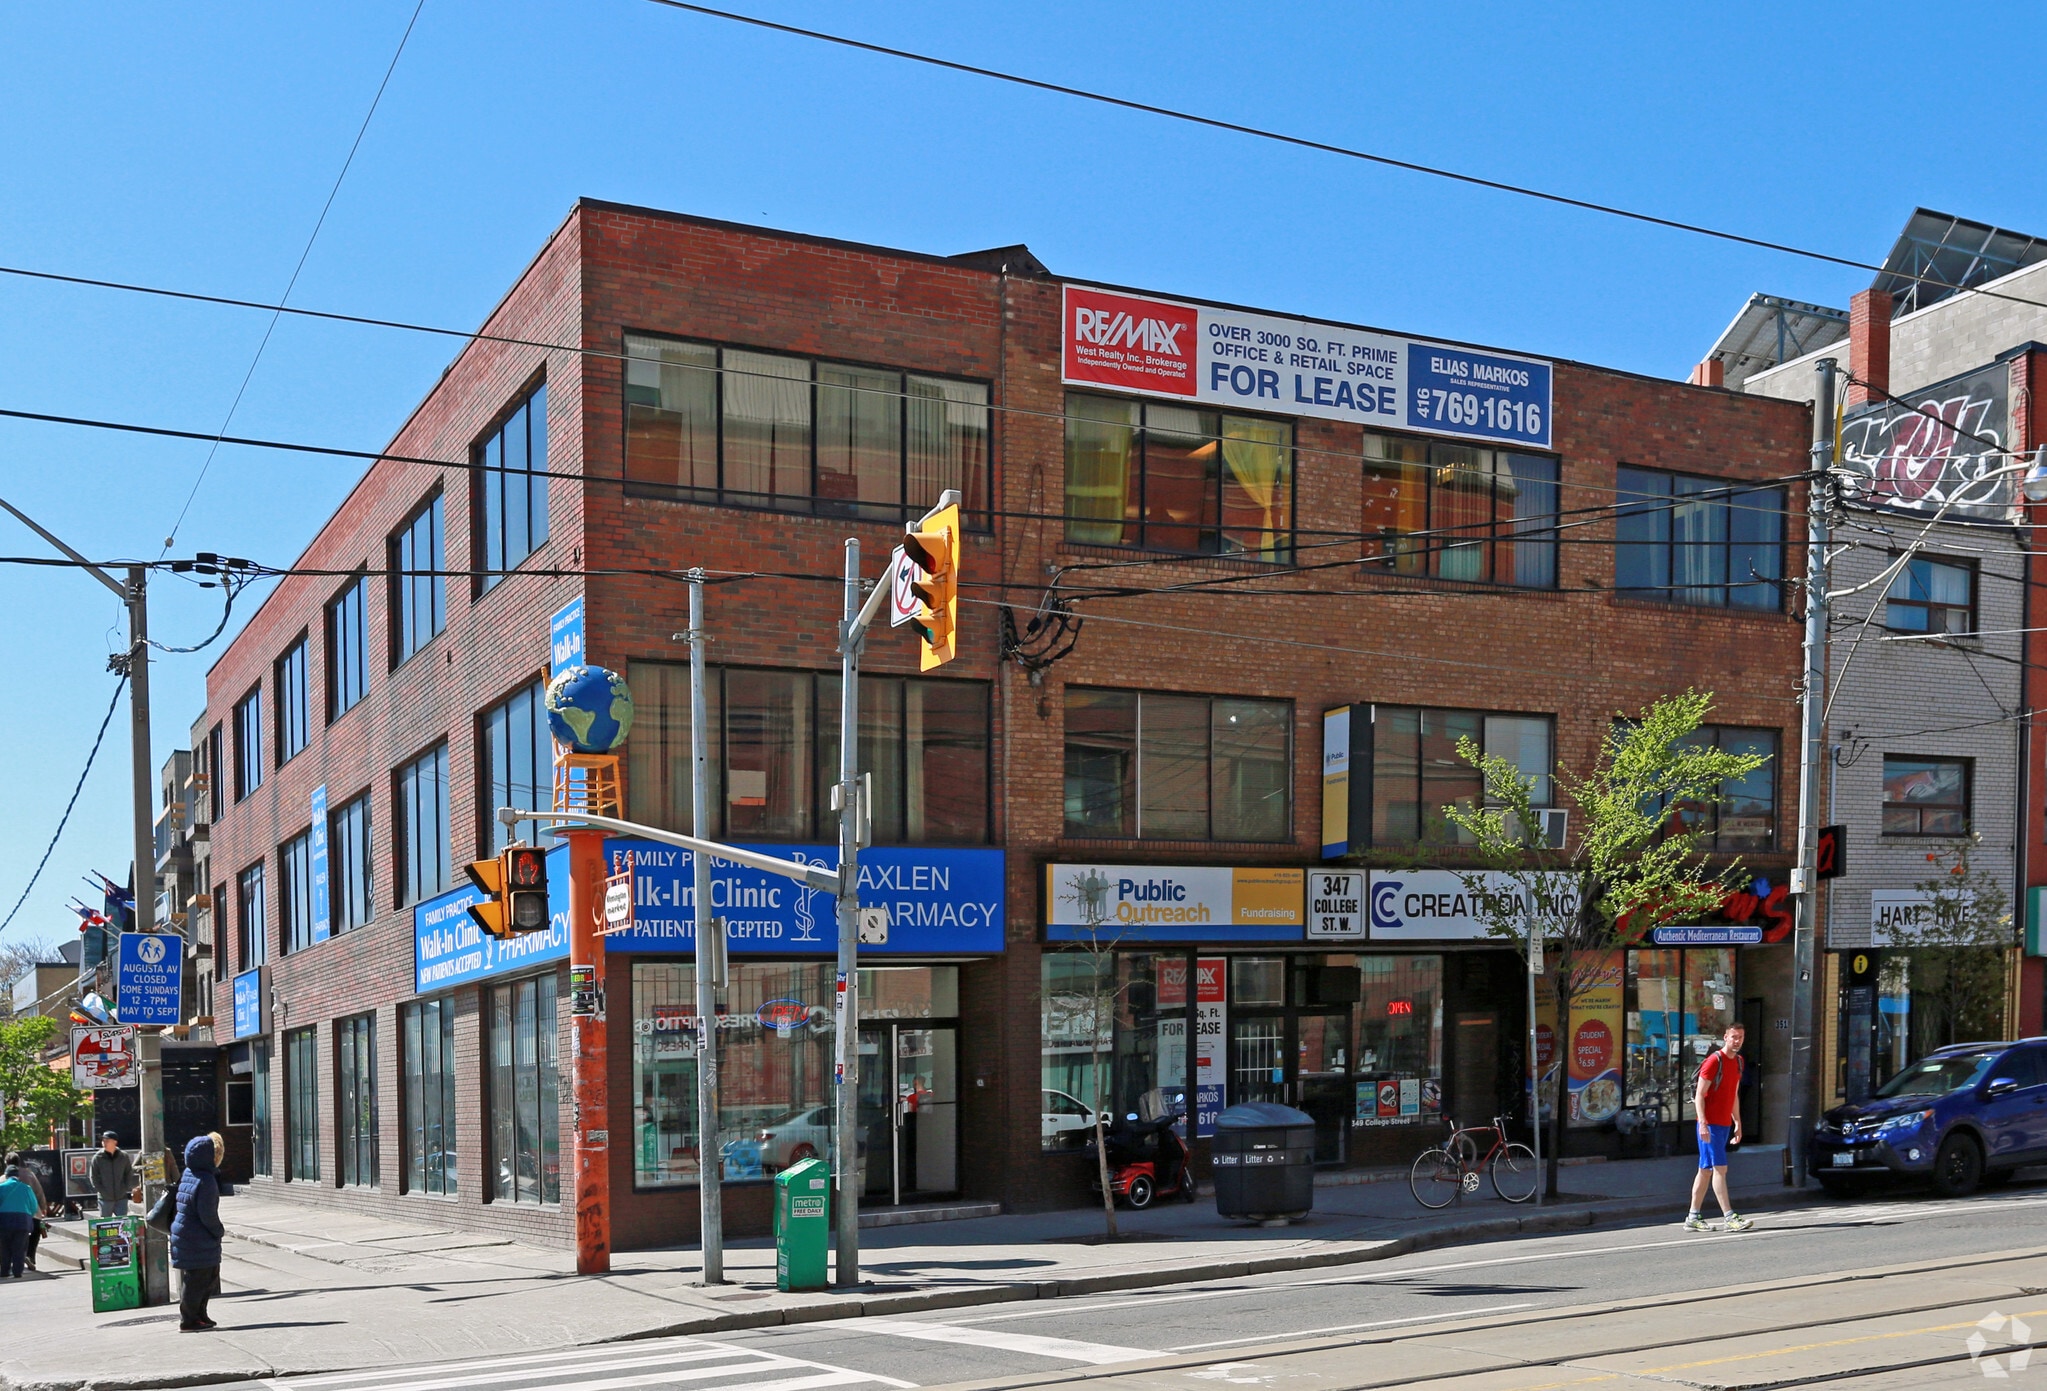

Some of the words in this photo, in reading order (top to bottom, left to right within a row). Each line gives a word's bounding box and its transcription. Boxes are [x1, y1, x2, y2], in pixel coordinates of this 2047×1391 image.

[1208, 323, 1251, 342] OVER
[1257, 331, 1291, 348] 3000
[1296, 336, 1321, 353] SQ.
[1327, 342, 1346, 357] FT.
[1352, 345, 1398, 364] PRIME
[1075, 345, 1097, 356] West
[1098, 347, 1125, 362] Realty
[1145, 355, 1188, 371] Brokerage
[1212, 341, 1268, 362] OFFICE
[1273, 350, 1284, 365] &
[1290, 353, 1342, 373] RETAIL
[1347, 361, 1394, 381] SPACE
[1077, 356, 1121, 371] Independently
[1122, 363, 1144, 373] Owned
[1145, 365, 1157, 375] and
[1157, 368, 1186, 379] Operated
[1430, 356, 1469, 378] ELIAS
[1473, 363, 1530, 387] MARKOS
[1211, 361, 1280, 400] FOR
[1294, 373, 1397, 416] LEASE
[1449, 378, 1467, 386] SALES
[1467, 380, 1511, 393] REPRESENTATIVE
[1416, 387, 1430, 419] 416
[553, 631, 580, 667] Walk-In
[612, 850, 677, 868] FAMILY
[854, 864, 950, 891] AXLEN
[632, 876, 695, 908] lk-In
[710, 878, 781, 909] Clinic
[1117, 878, 1186, 901] Public
[1323, 876, 1350, 896] 347
[425, 906, 446, 927] FAMILY
[445, 895, 474, 919] PRACTICE
[1115, 900, 1210, 923] Outreach
[1240, 907, 1296, 919] Fundraising
[1314, 898, 1358, 914] COLLEGE
[633, 919, 697, 938] PATIENT
[1321, 917, 1338, 931] ST.
[1339, 917, 1352, 931] W.
[420, 926, 454, 961] Walk-In
[454, 918, 482, 950] Clinic
[498, 909, 571, 963] PHARMACY
[1657, 929, 1687, 942] Authentic
[1687, 928, 1728, 942] Mediterranean
[1728, 928, 1759, 942] Restaurant
[122, 963, 164, 973] AUGUSTA
[166, 965, 179, 974] AV
[420, 967, 432, 985] NEW
[431, 958, 455, 982] PATIENTS
[454, 950, 483, 976] ACCEPTED
[133, 974, 167, 984] CLOSED
[121, 984, 142, 994] SOME
[144, 985, 179, 995] SUNDAYS
[132, 995, 141, 1005] 12
[150, 996, 168, 1006] 7PM
[1387, 1001, 1412, 1015] OPEN
[120, 1006, 140, 1015] MAY
[142, 1007, 154, 1016] TO
[157, 1007, 178, 1016] SEPT
[1209, 1007, 1221, 1018] Ft.
[1162, 1022, 1184, 1036] FOR
[1197, 1021, 1221, 1035] EASE
[1775, 1020, 1789, 1030] 351
[1579, 1031, 1605, 1040] STUDENT
[1578, 1045, 1603, 1055] SPECIAL
[1351, 1119, 1364, 1128] 349
[1364, 1118, 1390, 1126] College
[1390, 1117, 1410, 1125] Street
[1221, 1155, 1238, 1164] Litter
[1245, 1155, 1263, 1164] Litter
[794, 1198, 821, 1208] metro
